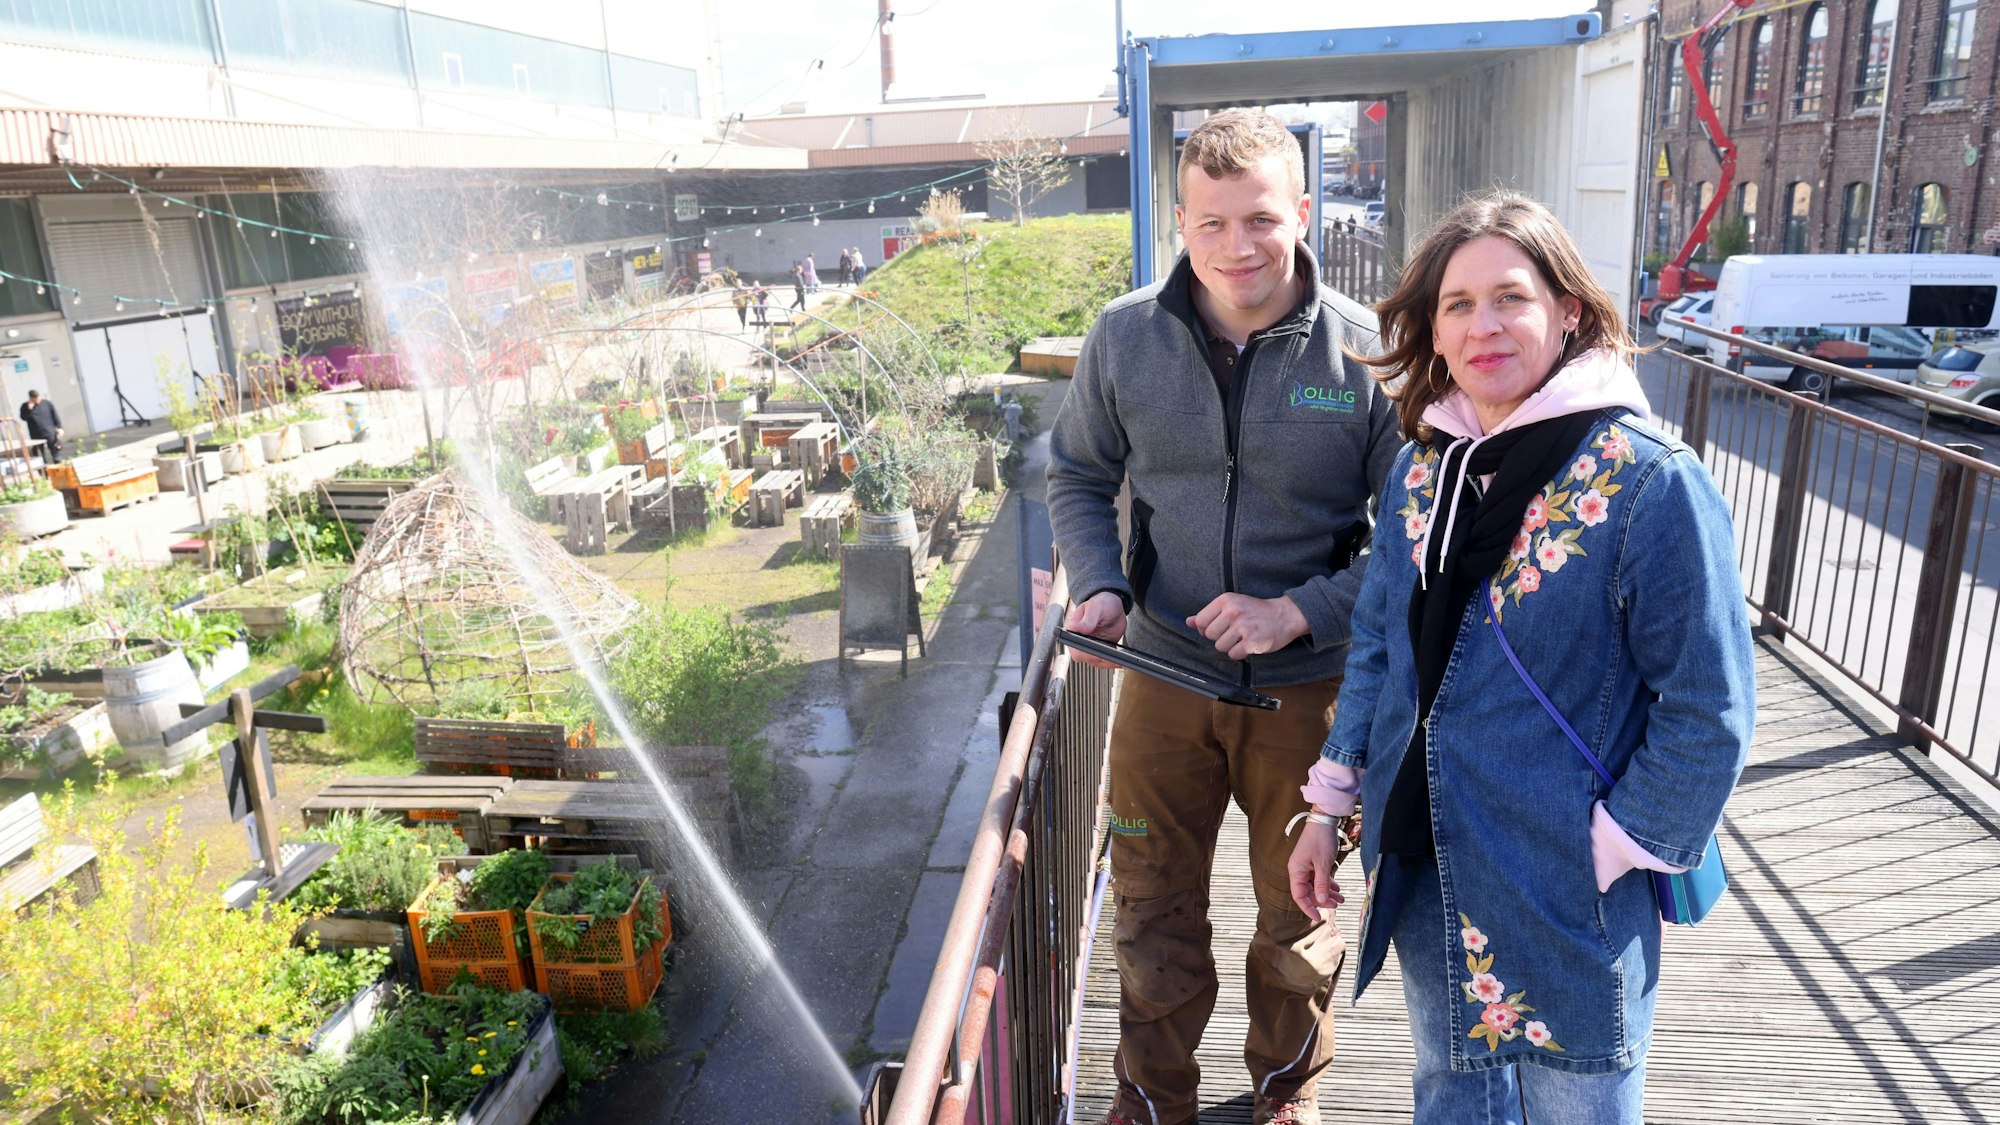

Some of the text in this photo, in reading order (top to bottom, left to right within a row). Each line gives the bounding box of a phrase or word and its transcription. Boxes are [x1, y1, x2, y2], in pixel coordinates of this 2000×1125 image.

[1930, 272, 1994, 280] Industrieböden
[283, 303, 359, 331] BODY WITHOUT
[303, 322, 347, 344] ORGANS
